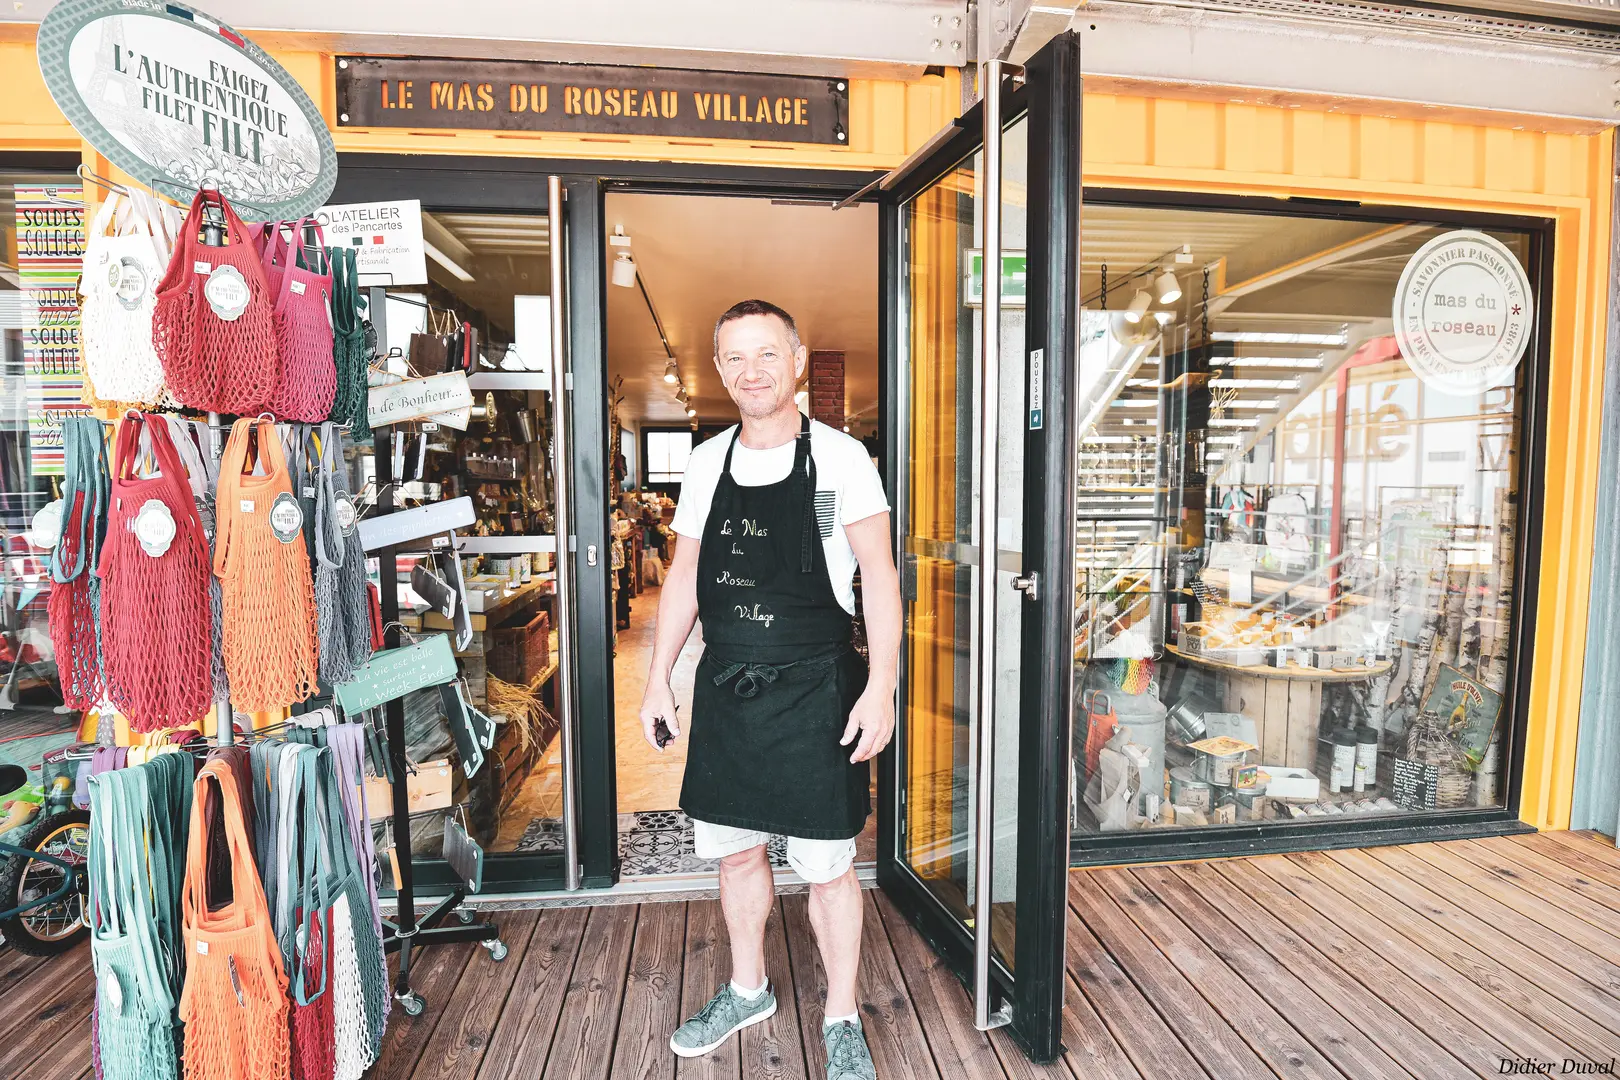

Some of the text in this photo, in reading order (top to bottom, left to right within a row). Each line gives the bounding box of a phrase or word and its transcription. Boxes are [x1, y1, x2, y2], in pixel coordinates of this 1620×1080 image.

[122, 0, 277, 72] Made in France
[209, 59, 269, 104] EXIGEZ
[114, 44, 288, 138] L'AUTHENTIQUE
[381, 79, 809, 126] LE MAS DU ROSEAU VILLAGE
[142, 86, 264, 166] FILET FILT
[23, 209, 81, 227] SOLDES
[232, 206, 253, 217] 860
[331, 207, 400, 223] L'ATELIER
[332, 221, 403, 234] des Pancartes
[25, 229, 82, 256] SOLDES
[370, 245, 410, 255] Fabrication
[357, 256, 390, 266] rtisanale
[1411, 247, 1521, 299] SAVONNIER PASSIONNÉ
[29, 289, 77, 307] SOLDE
[1433, 292, 1497, 310] mas du
[34, 309, 81, 326] OLDE
[30, 328, 79, 345] SOLDE
[1431, 319, 1497, 337] roseau
[1505, 322, 1520, 354] 1983
[32, 348, 80, 375] SOLDE
[380, 398, 395, 413] de
[397, 389, 463, 409] Bonheur...
[37, 429, 64, 446] SOL
[720, 518, 768, 536] Le Mas
[731, 542, 744, 555] du
[716, 570, 756, 587] Roseau
[734, 603, 775, 628] Village
[356, 648, 434, 684] La vie est belle
[382, 667, 416, 685] surtout
[359, 697, 370, 708] le
